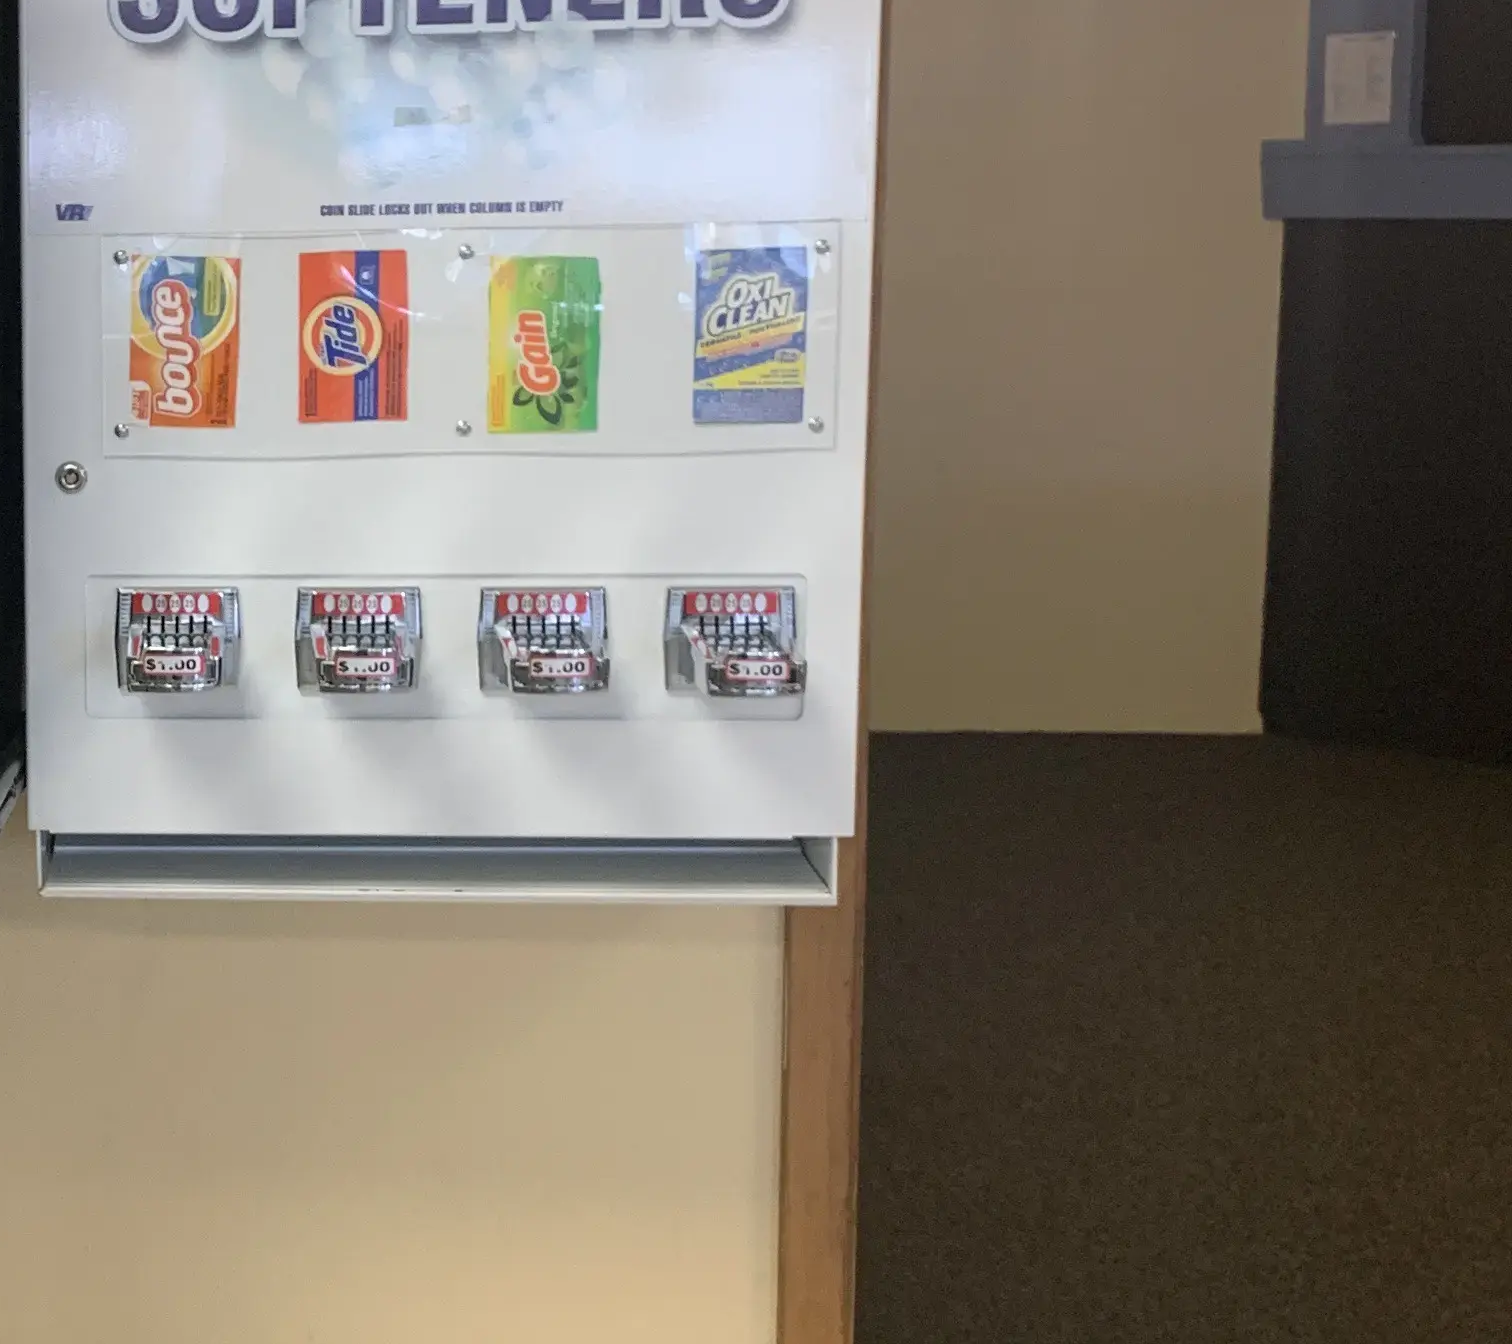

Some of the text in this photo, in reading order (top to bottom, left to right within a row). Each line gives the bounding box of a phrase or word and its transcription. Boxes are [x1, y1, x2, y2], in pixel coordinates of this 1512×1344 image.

[320, 200, 563, 217] COIN SLIDE LOCKS OUT WHEN COLUMN IS EMPTY
[708, 292, 790, 336] CLEAN
[727, 278, 775, 307] OXI
[152, 282, 197, 417] bounce
[322, 302, 369, 369] Tide
[513, 311, 559, 394] Gain
